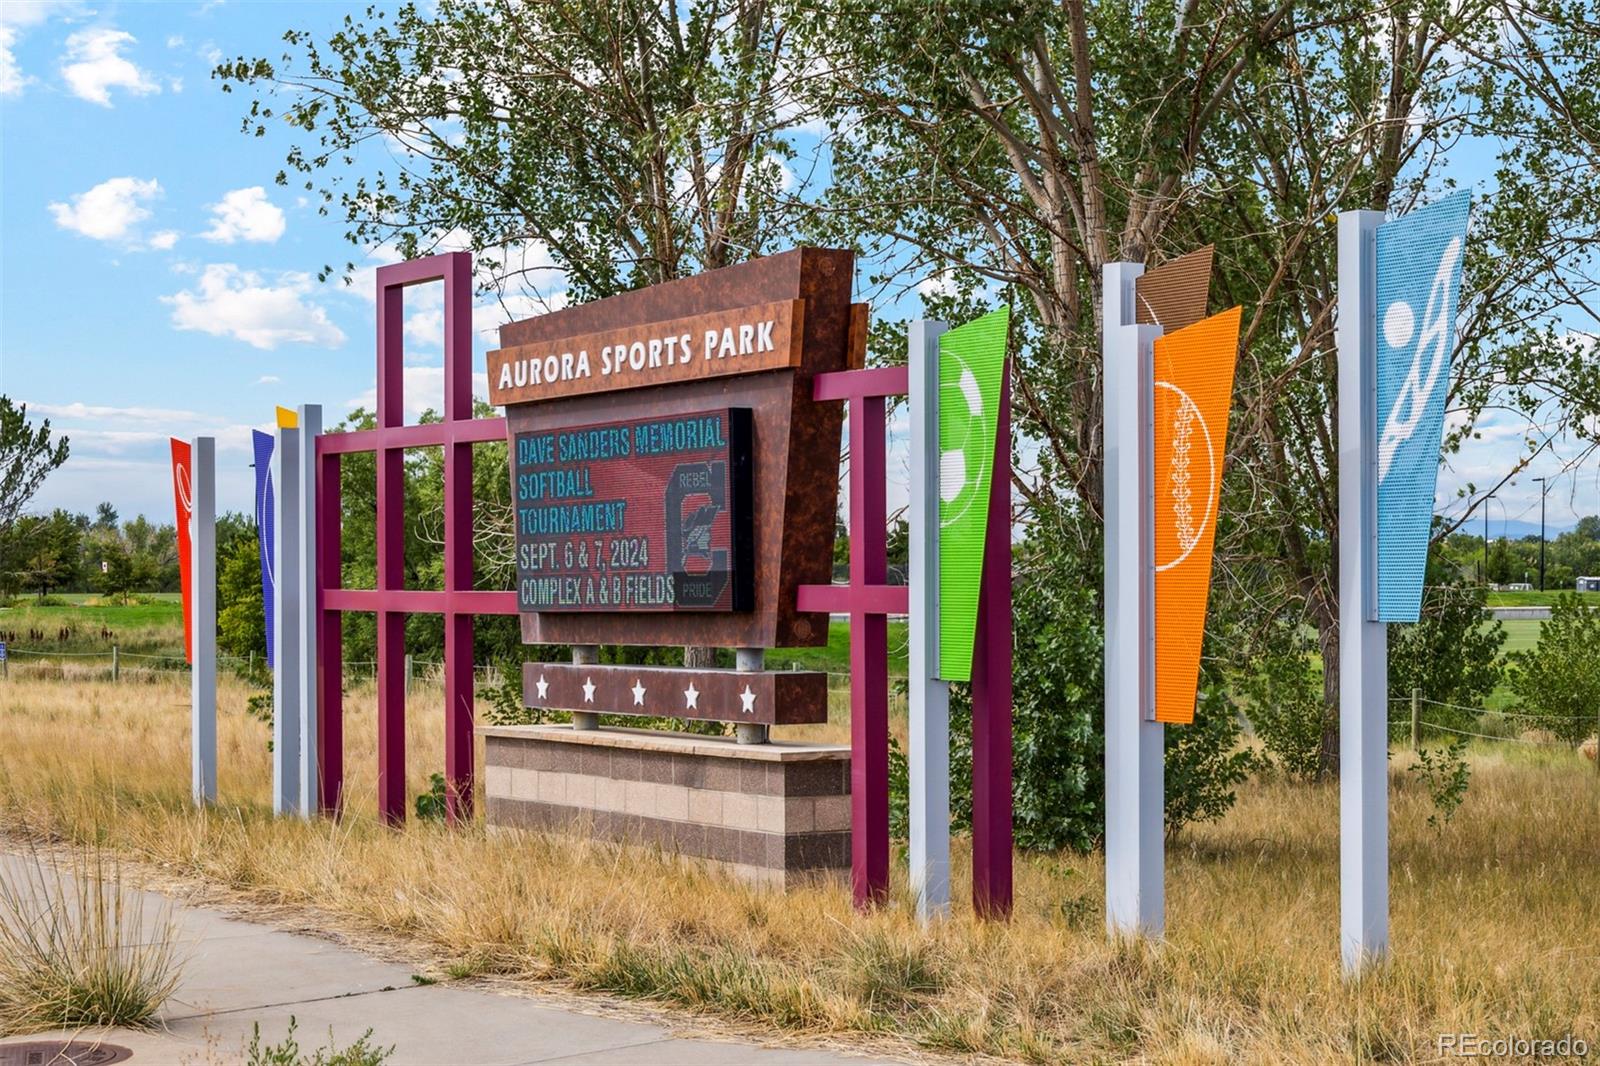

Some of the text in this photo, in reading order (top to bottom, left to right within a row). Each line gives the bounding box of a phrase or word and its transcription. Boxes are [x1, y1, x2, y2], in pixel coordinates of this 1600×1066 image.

[499, 321, 774, 389] AURORA SPORTS PARK
[518, 418, 725, 466] DAVE SANDERS MEMORIAL
[519, 469, 593, 499] SOFTBALL
[679, 471, 711, 488] REBEL
[519, 502, 626, 534] TOURNAMENT
[520, 544, 560, 570] SEPT.
[565, 545, 573, 568] 6
[578, 543, 589, 568] &
[610, 539, 649, 567] 2024
[521, 574, 676, 605] COMPLEX A & B FIELDS
[682, 582, 712, 598] PRIDE
